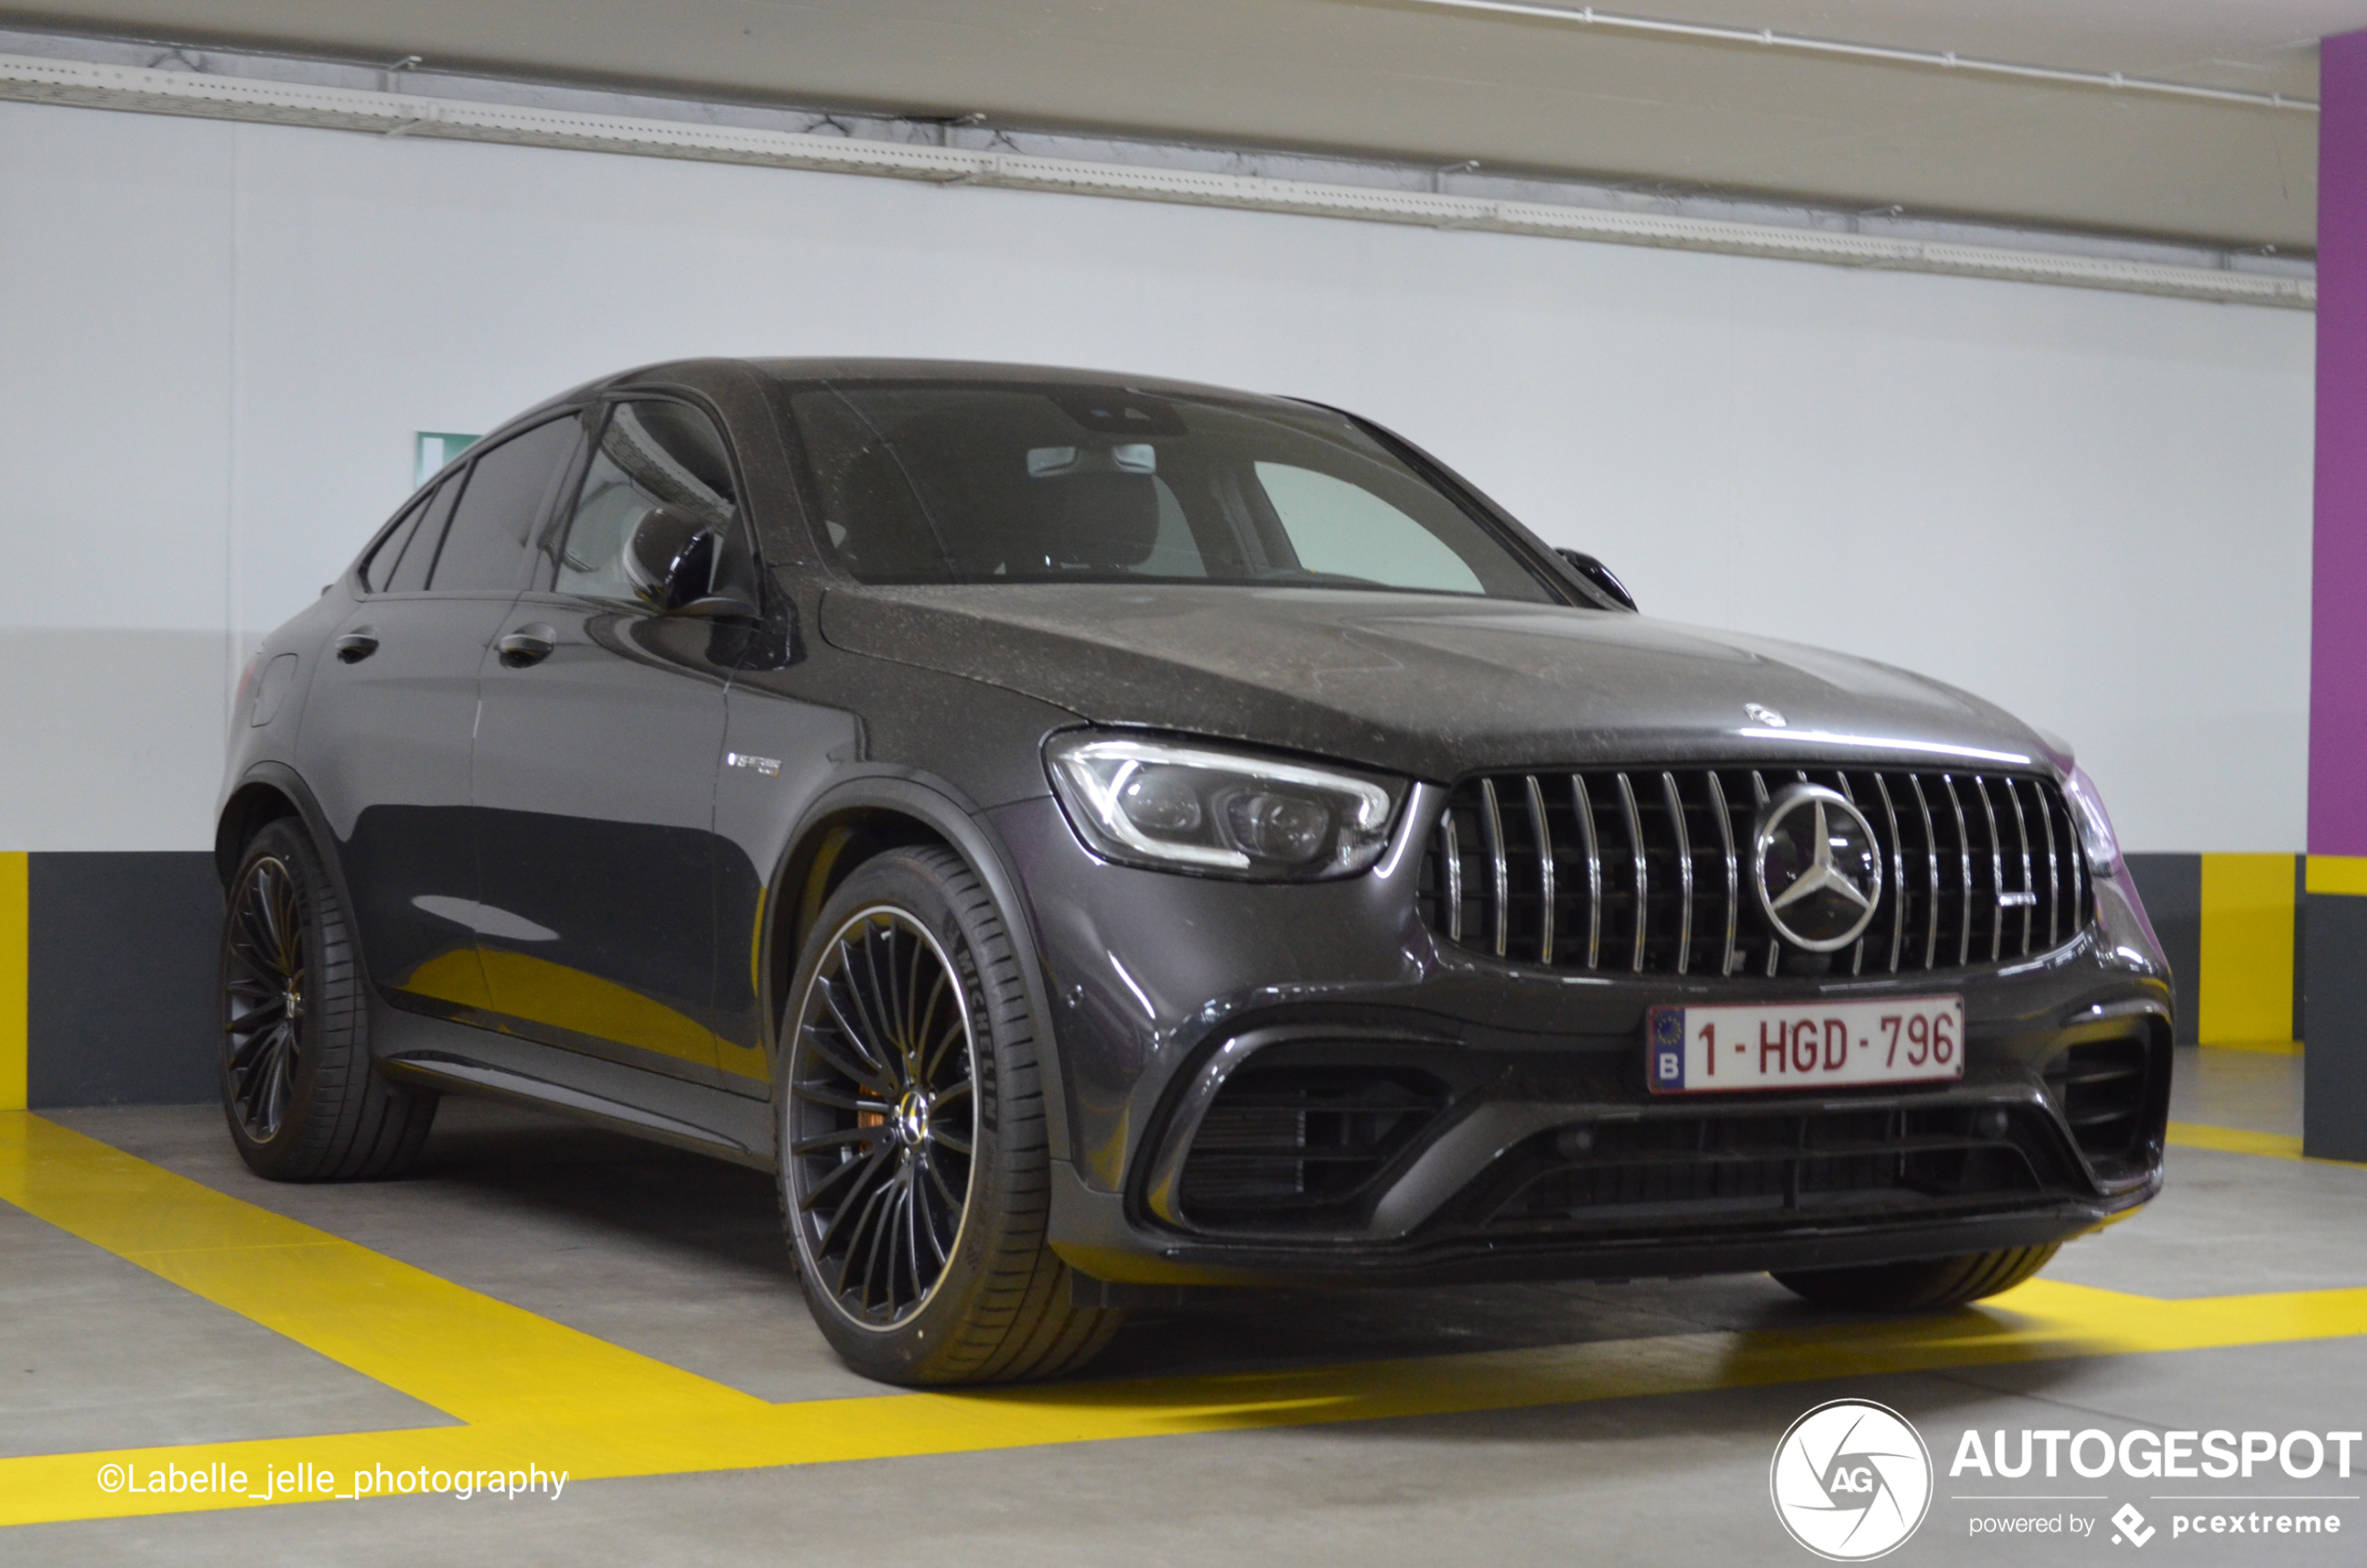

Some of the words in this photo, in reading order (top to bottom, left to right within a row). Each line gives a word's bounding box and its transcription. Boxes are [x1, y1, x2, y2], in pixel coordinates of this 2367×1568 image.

[956, 949, 998, 1125] MICHELIN
[1659, 1053, 1679, 1080] B
[1698, 1013, 1954, 1076] 1-HGD-796
